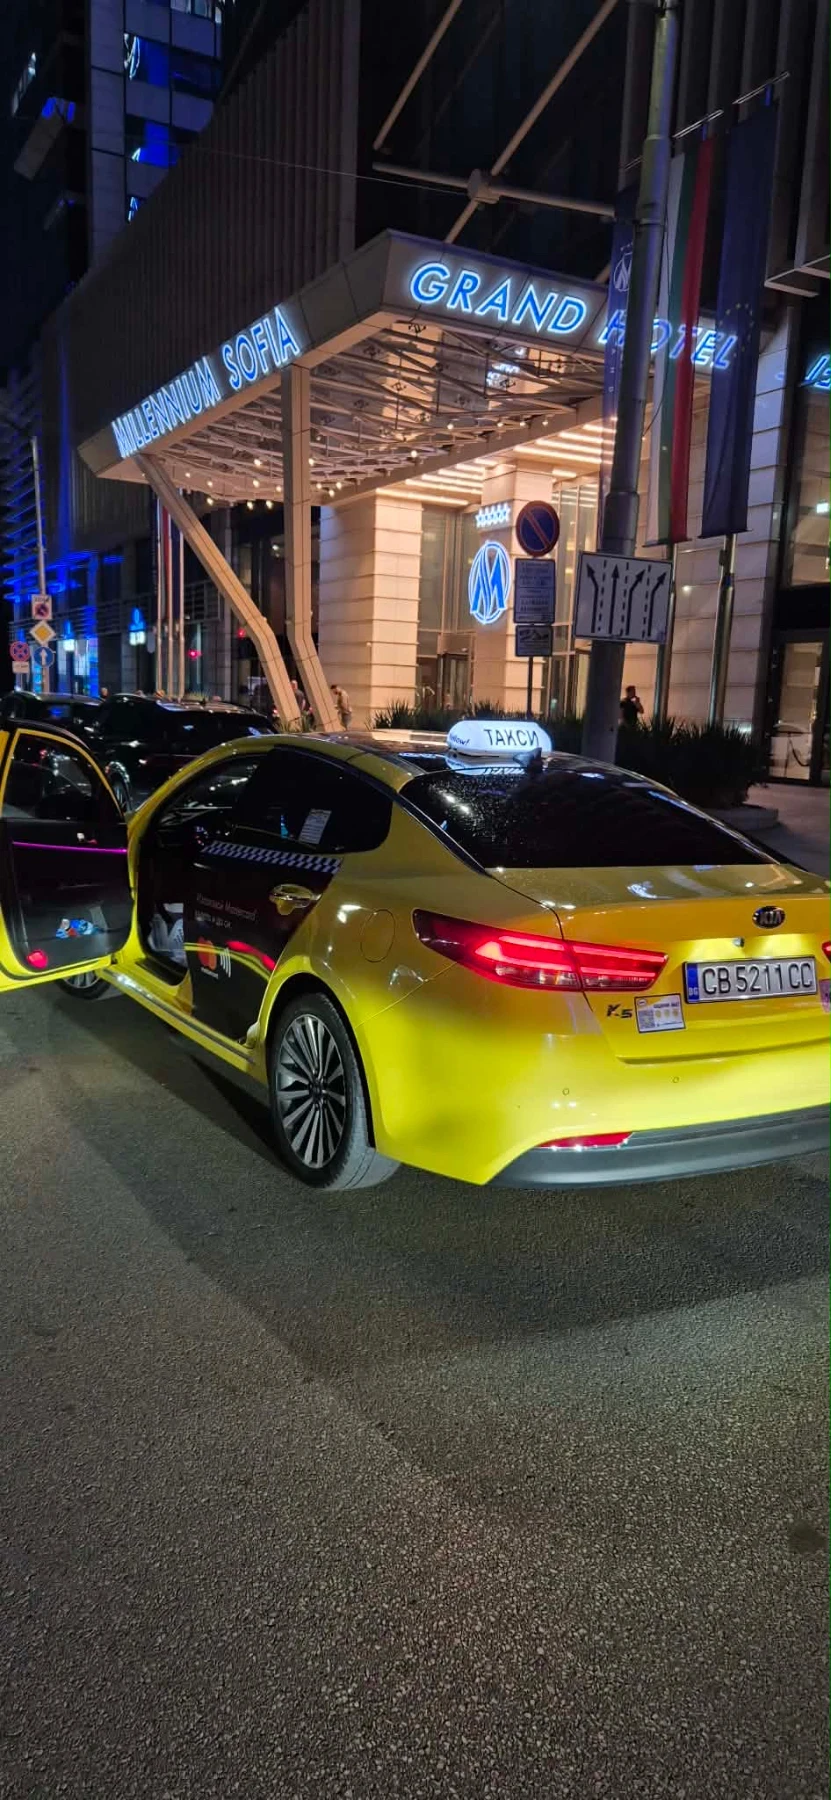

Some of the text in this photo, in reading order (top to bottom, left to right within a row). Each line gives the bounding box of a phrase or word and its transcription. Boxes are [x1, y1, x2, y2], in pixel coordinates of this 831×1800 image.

[411, 263, 738, 368] GRAND HOTEL
[112, 306, 299, 458] MILLENNIUM SOFIA
[484, 729, 540, 746] ТАКСИ
[760, 911, 782, 924] KIA
[702, 962, 813, 994] CB 5211 CC
[607, 1003, 633, 1018] K5
